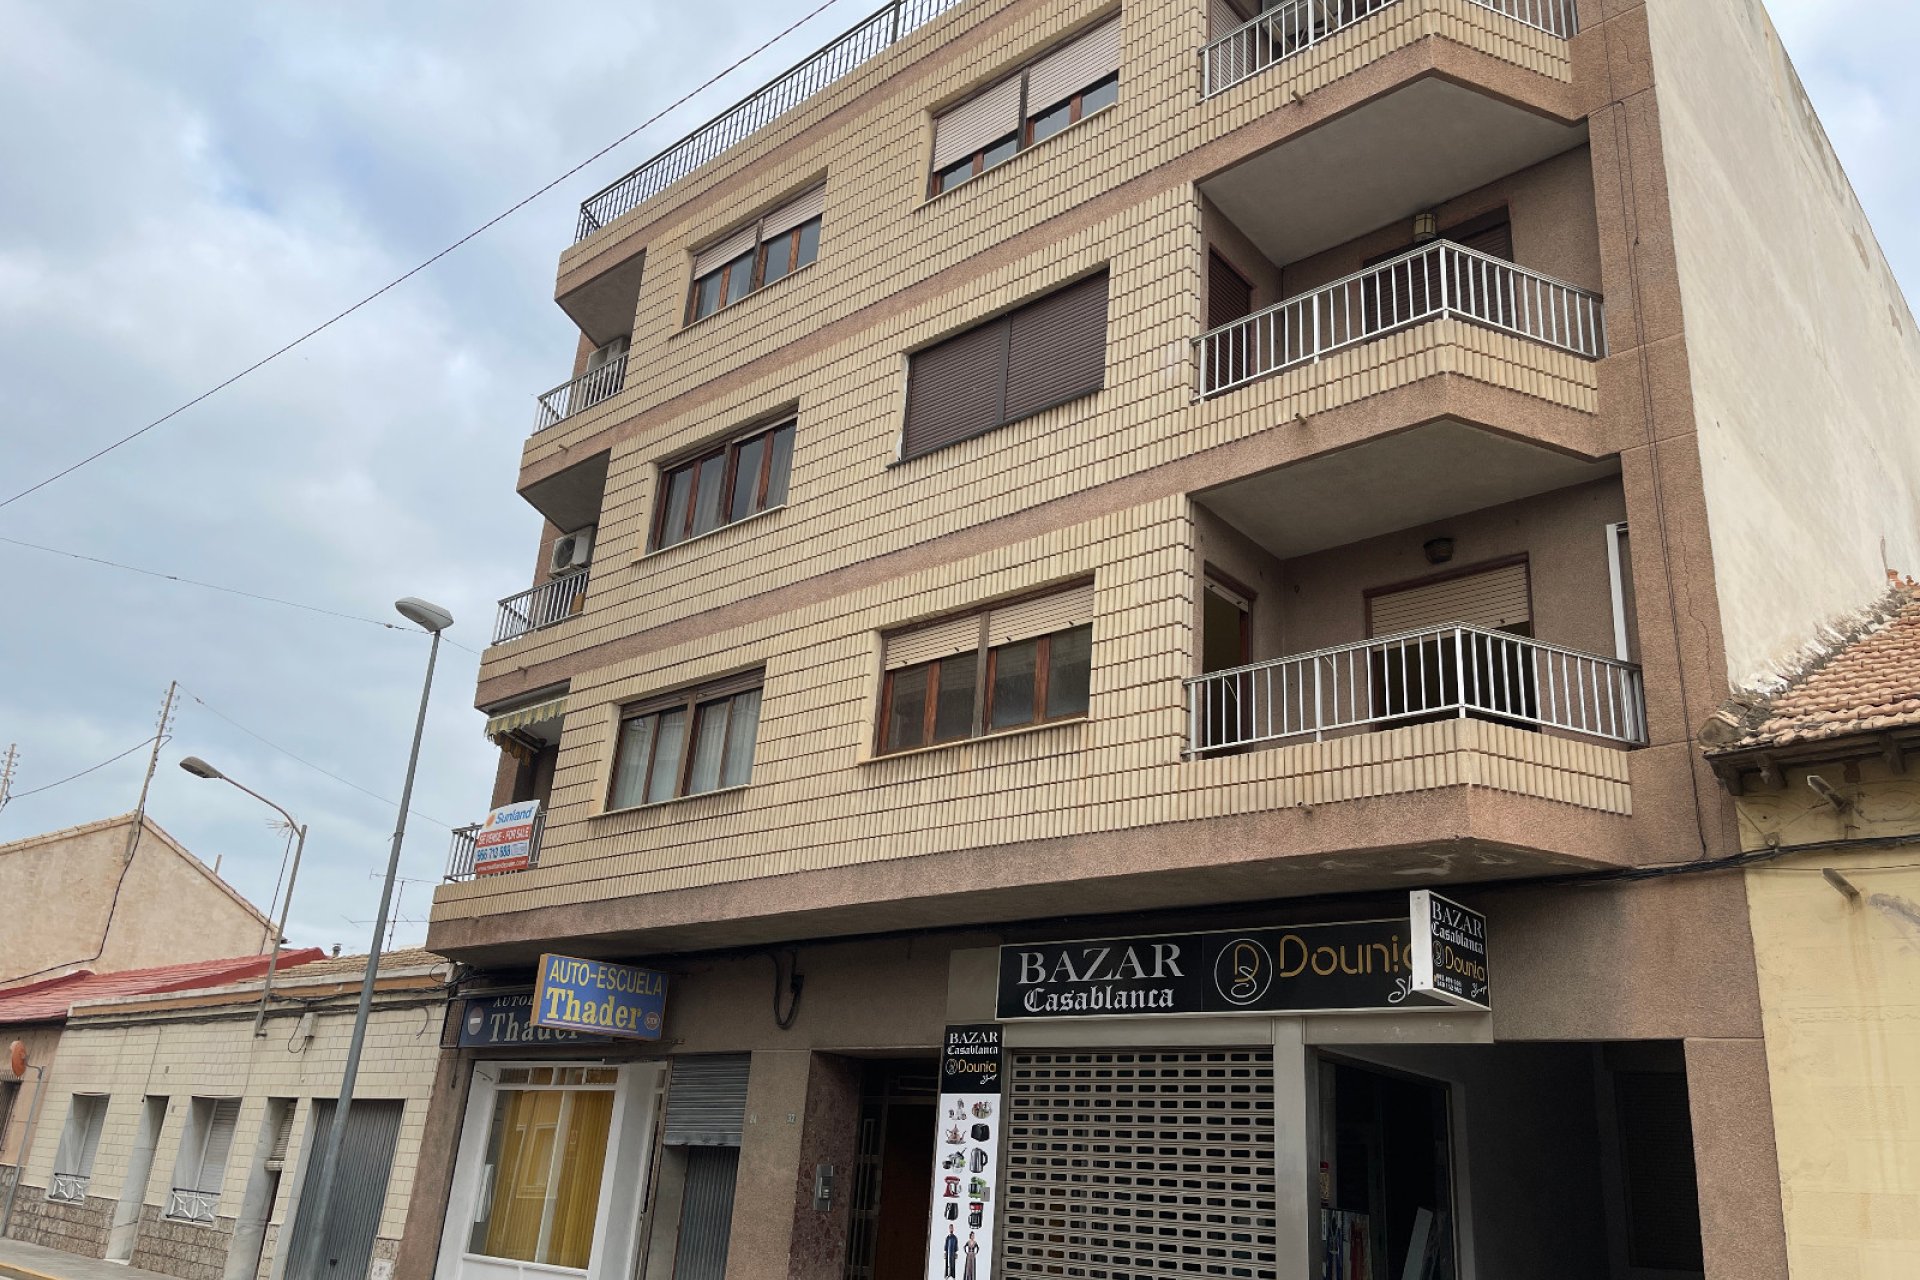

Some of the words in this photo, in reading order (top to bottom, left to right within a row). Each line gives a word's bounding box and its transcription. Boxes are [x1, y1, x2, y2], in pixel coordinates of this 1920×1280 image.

[495, 807, 534, 824] Sunland
[1431, 901, 1483, 939] BAZAR
[1431, 921, 1484, 955] Casablanca
[549, 959, 662, 996] AUTO-ESCUELA
[1016, 943, 1185, 985] BAZAR
[1445, 945, 1485, 982] Dounia
[545, 986, 642, 1031] Thader
[1023, 984, 1175, 1013] Casablanca
[947, 1044, 998, 1055] Casablanca
[949, 1031, 998, 1044] BAZAR
[959, 1058, 997, 1073] Dounia
